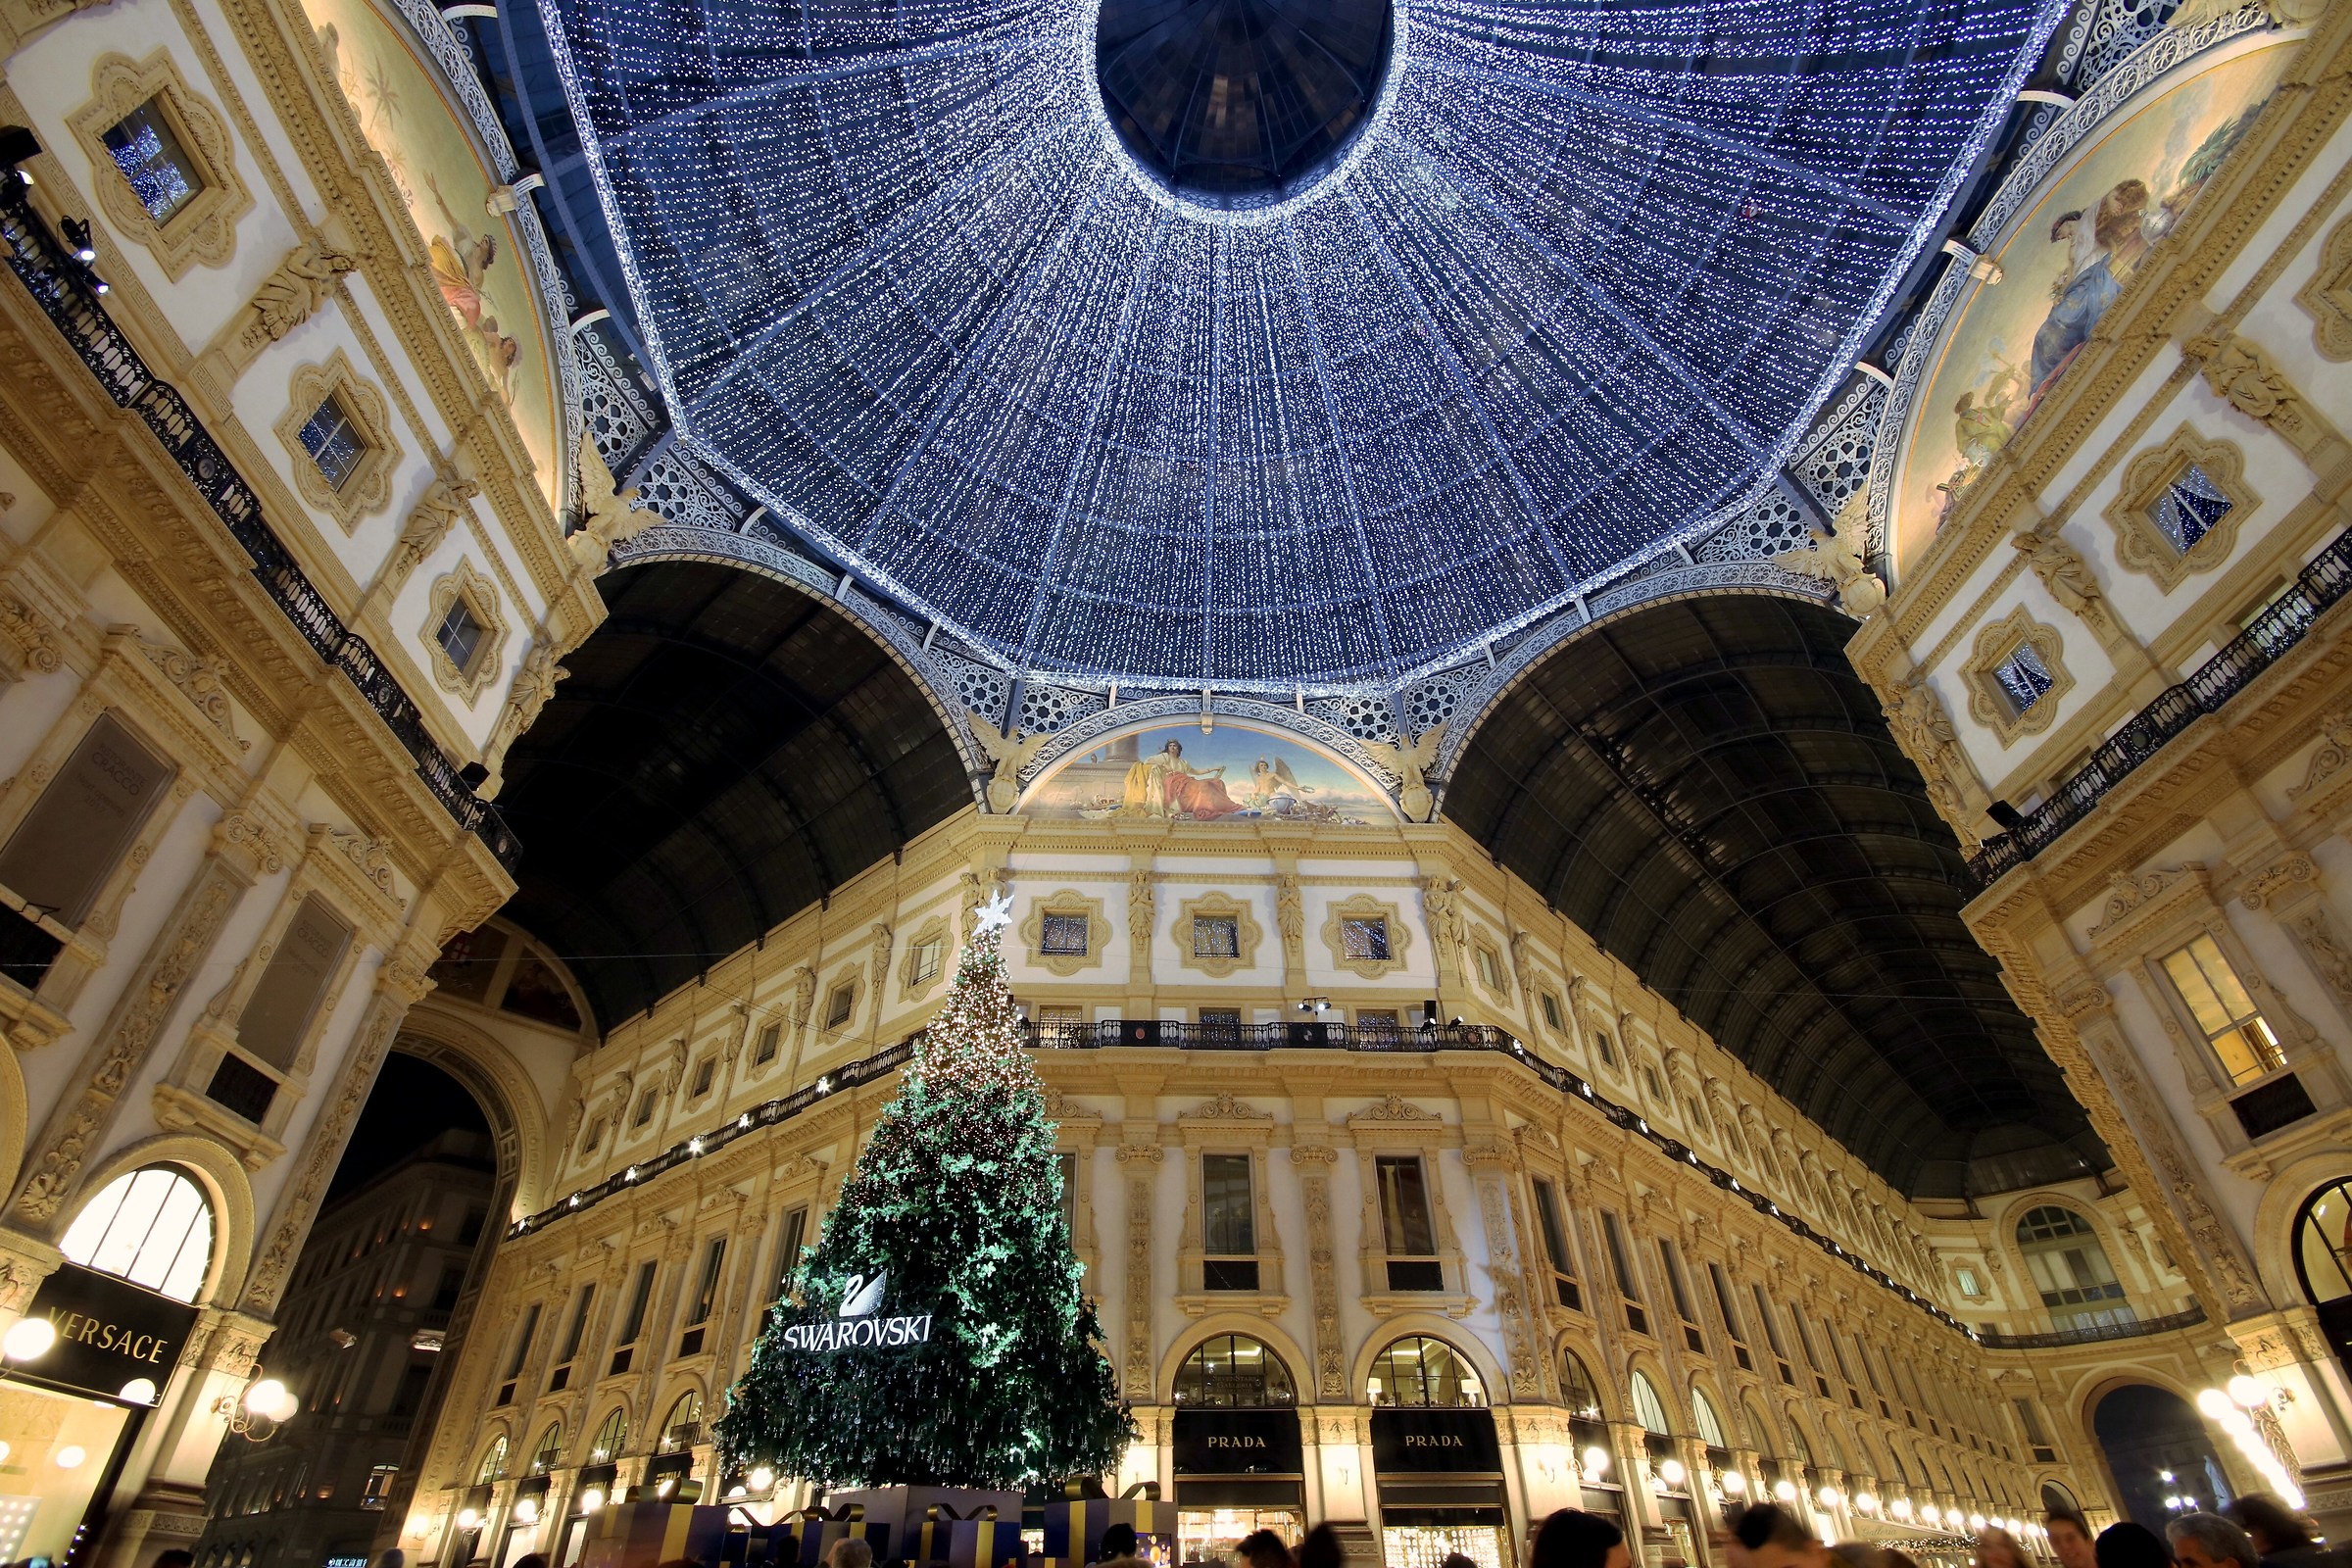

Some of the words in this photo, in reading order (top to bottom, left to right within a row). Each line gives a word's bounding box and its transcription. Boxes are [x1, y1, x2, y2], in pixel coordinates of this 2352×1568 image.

[92, 752, 140, 796] CRACCO
[48, 1306, 168, 1363] VERSACE
[784, 1314, 933, 1351] SWAROVSKI
[1207, 1436, 1266, 1448] PRADA
[1405, 1435, 1463, 1446] PRADA
